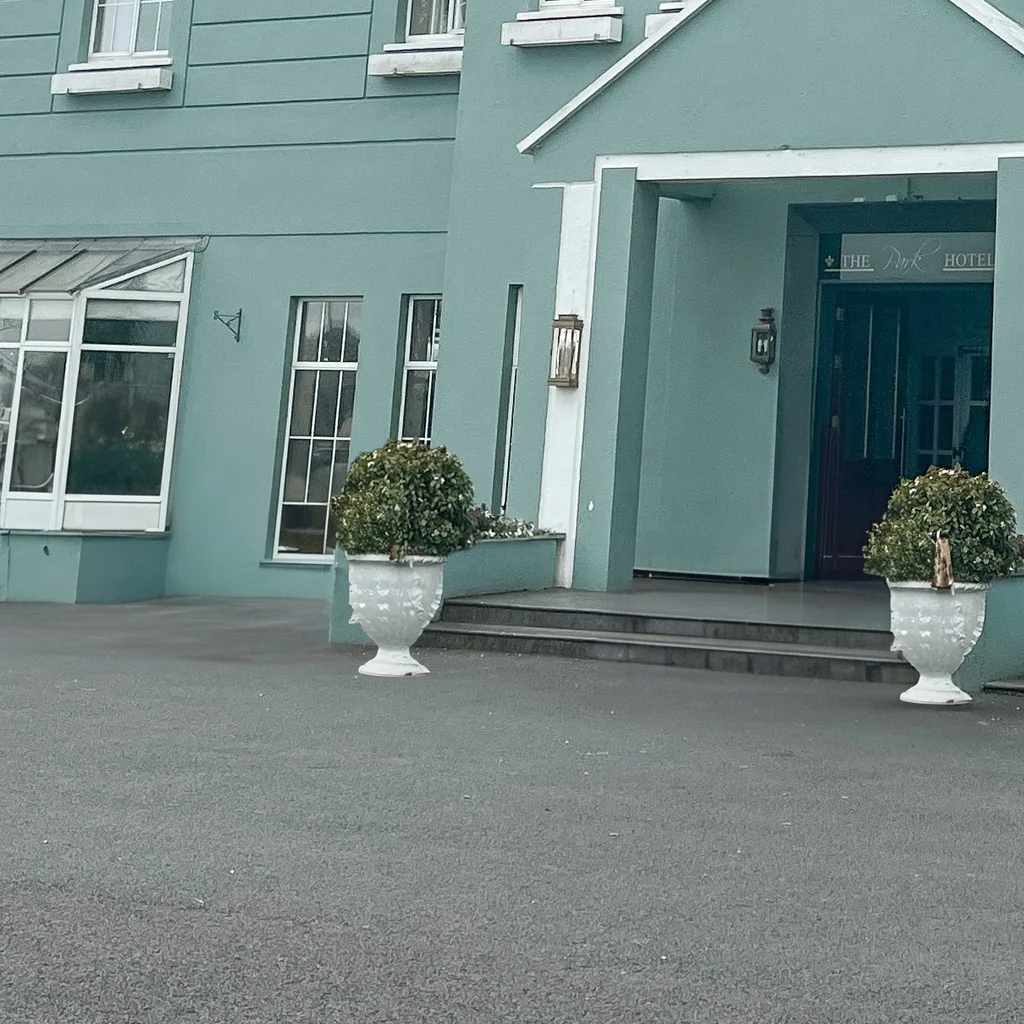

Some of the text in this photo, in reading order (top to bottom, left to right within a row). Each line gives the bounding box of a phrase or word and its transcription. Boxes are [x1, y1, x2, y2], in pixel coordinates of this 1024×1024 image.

[841, 238, 994, 275] THE Park HOTEL
